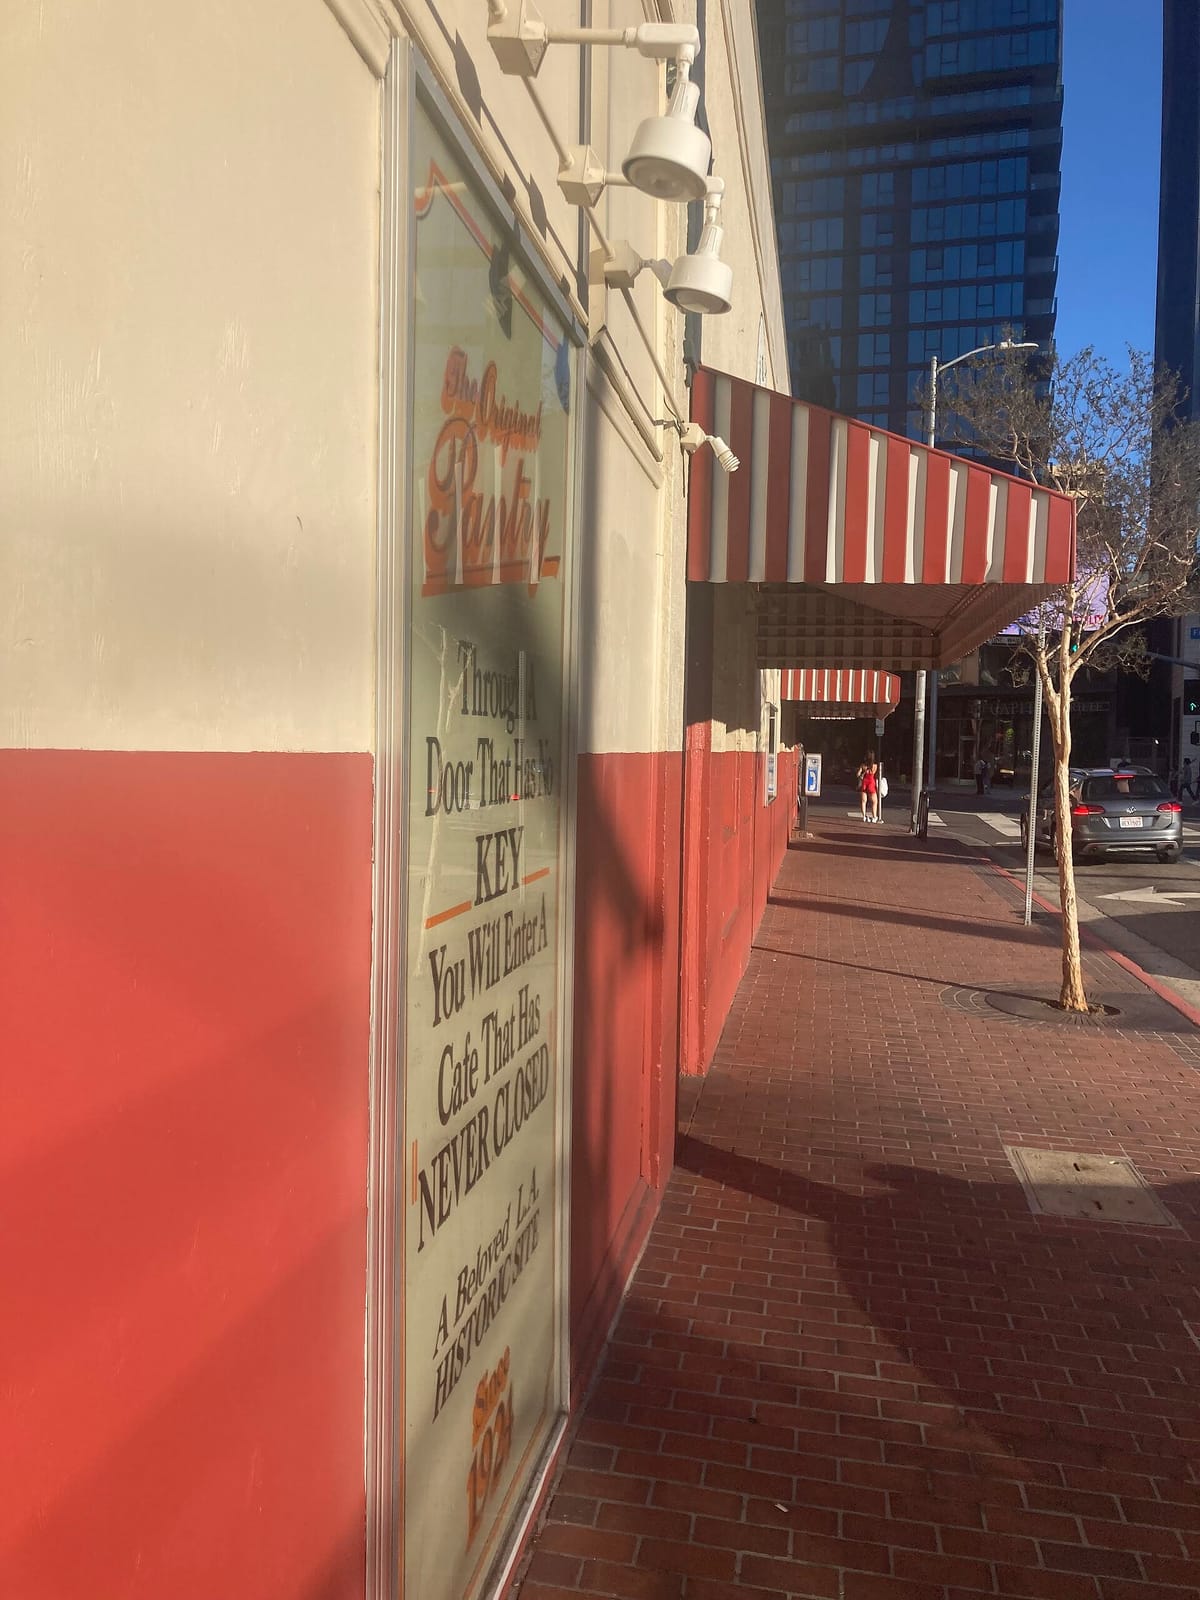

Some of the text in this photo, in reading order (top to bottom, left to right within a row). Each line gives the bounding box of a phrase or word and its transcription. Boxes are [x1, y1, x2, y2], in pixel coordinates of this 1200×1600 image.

[425, 737, 473, 816] Door
[477, 738, 511, 807] That
[474, 826, 524, 906] KEY
[429, 891, 548, 1028] You Will Enter A
[437, 983, 541, 1126] Cafe That Has
[417, 1043, 549, 1253] NEVER CLOSED
[433, 1294, 448, 1360] A
[453, 1202, 511, 1327] Beloved
[433, 1207, 539, 1424] HISTORIC SITE
